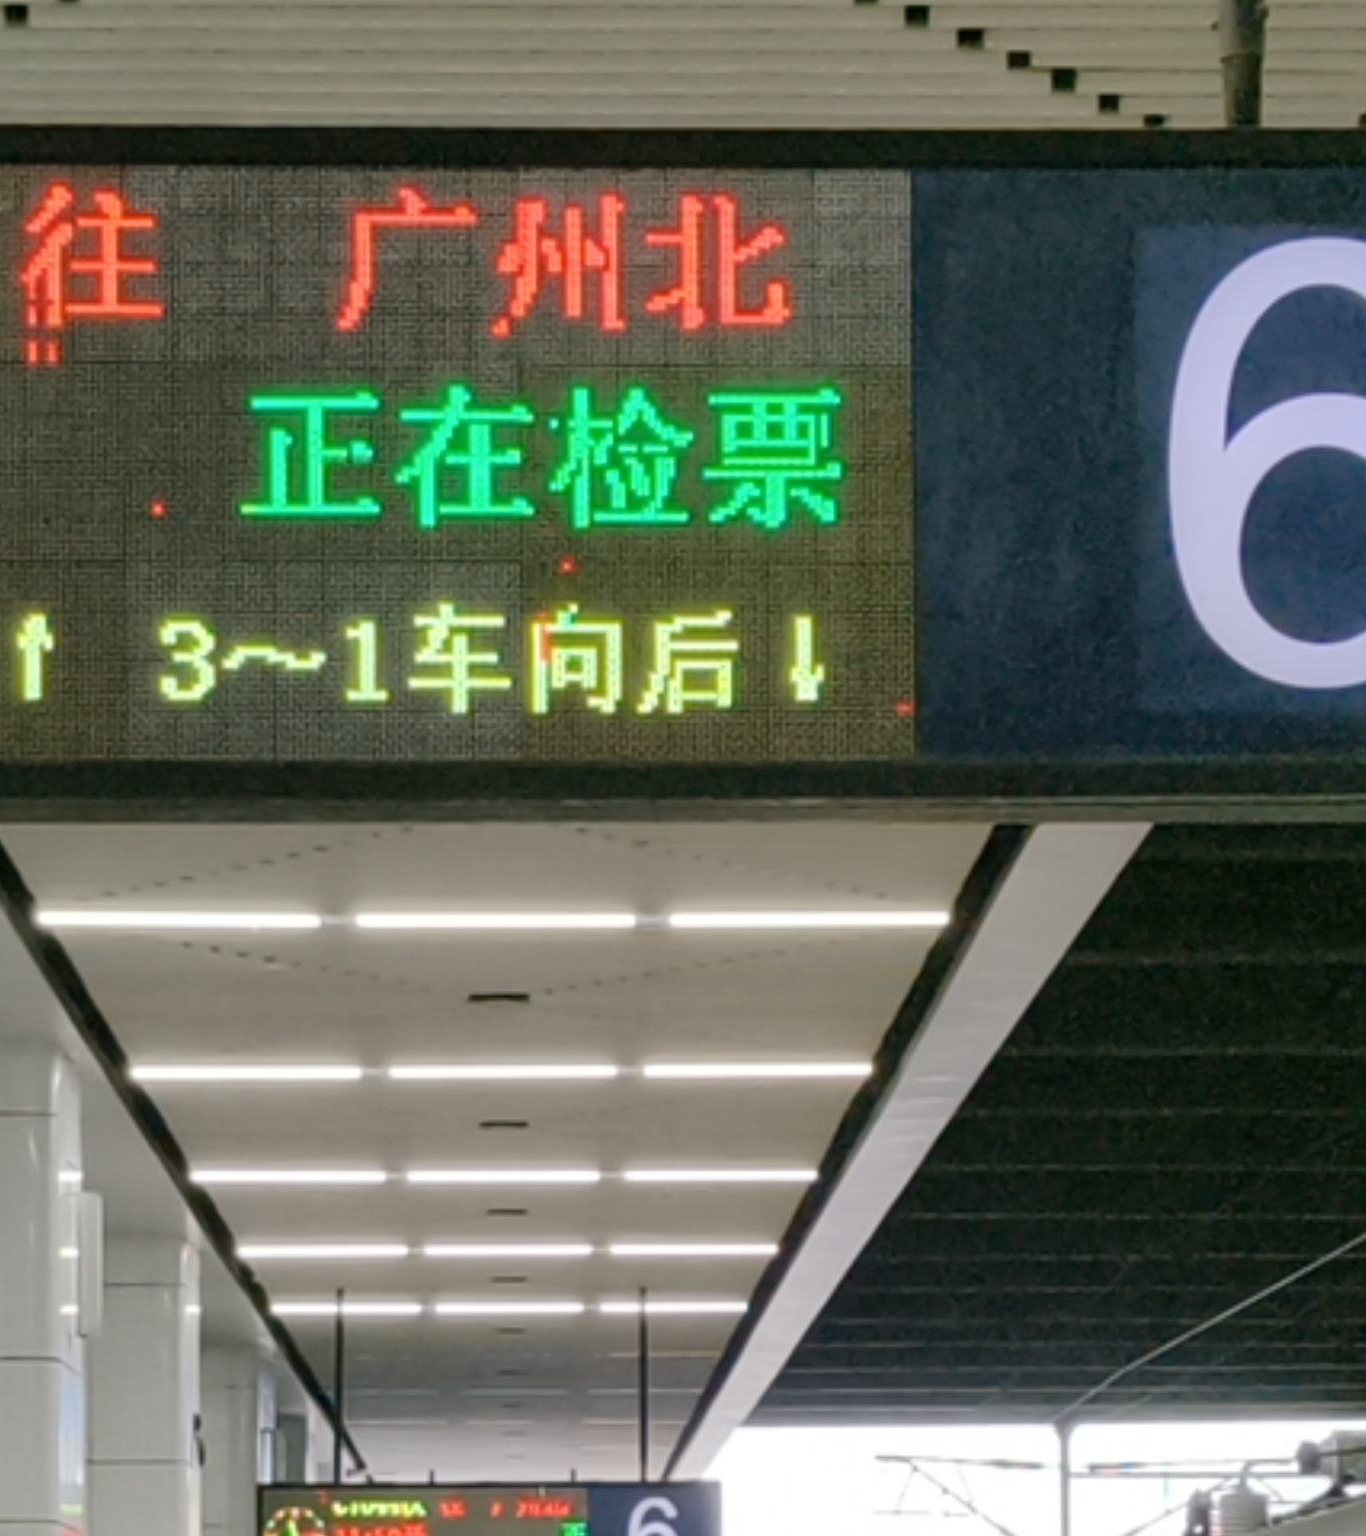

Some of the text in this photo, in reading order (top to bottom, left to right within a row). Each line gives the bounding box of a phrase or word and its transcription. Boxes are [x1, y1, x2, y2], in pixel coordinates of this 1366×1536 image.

[21, 182, 165, 360] 往
[336, 188, 794, 337] 广州北
[239, 384, 843, 529] 正在检票
